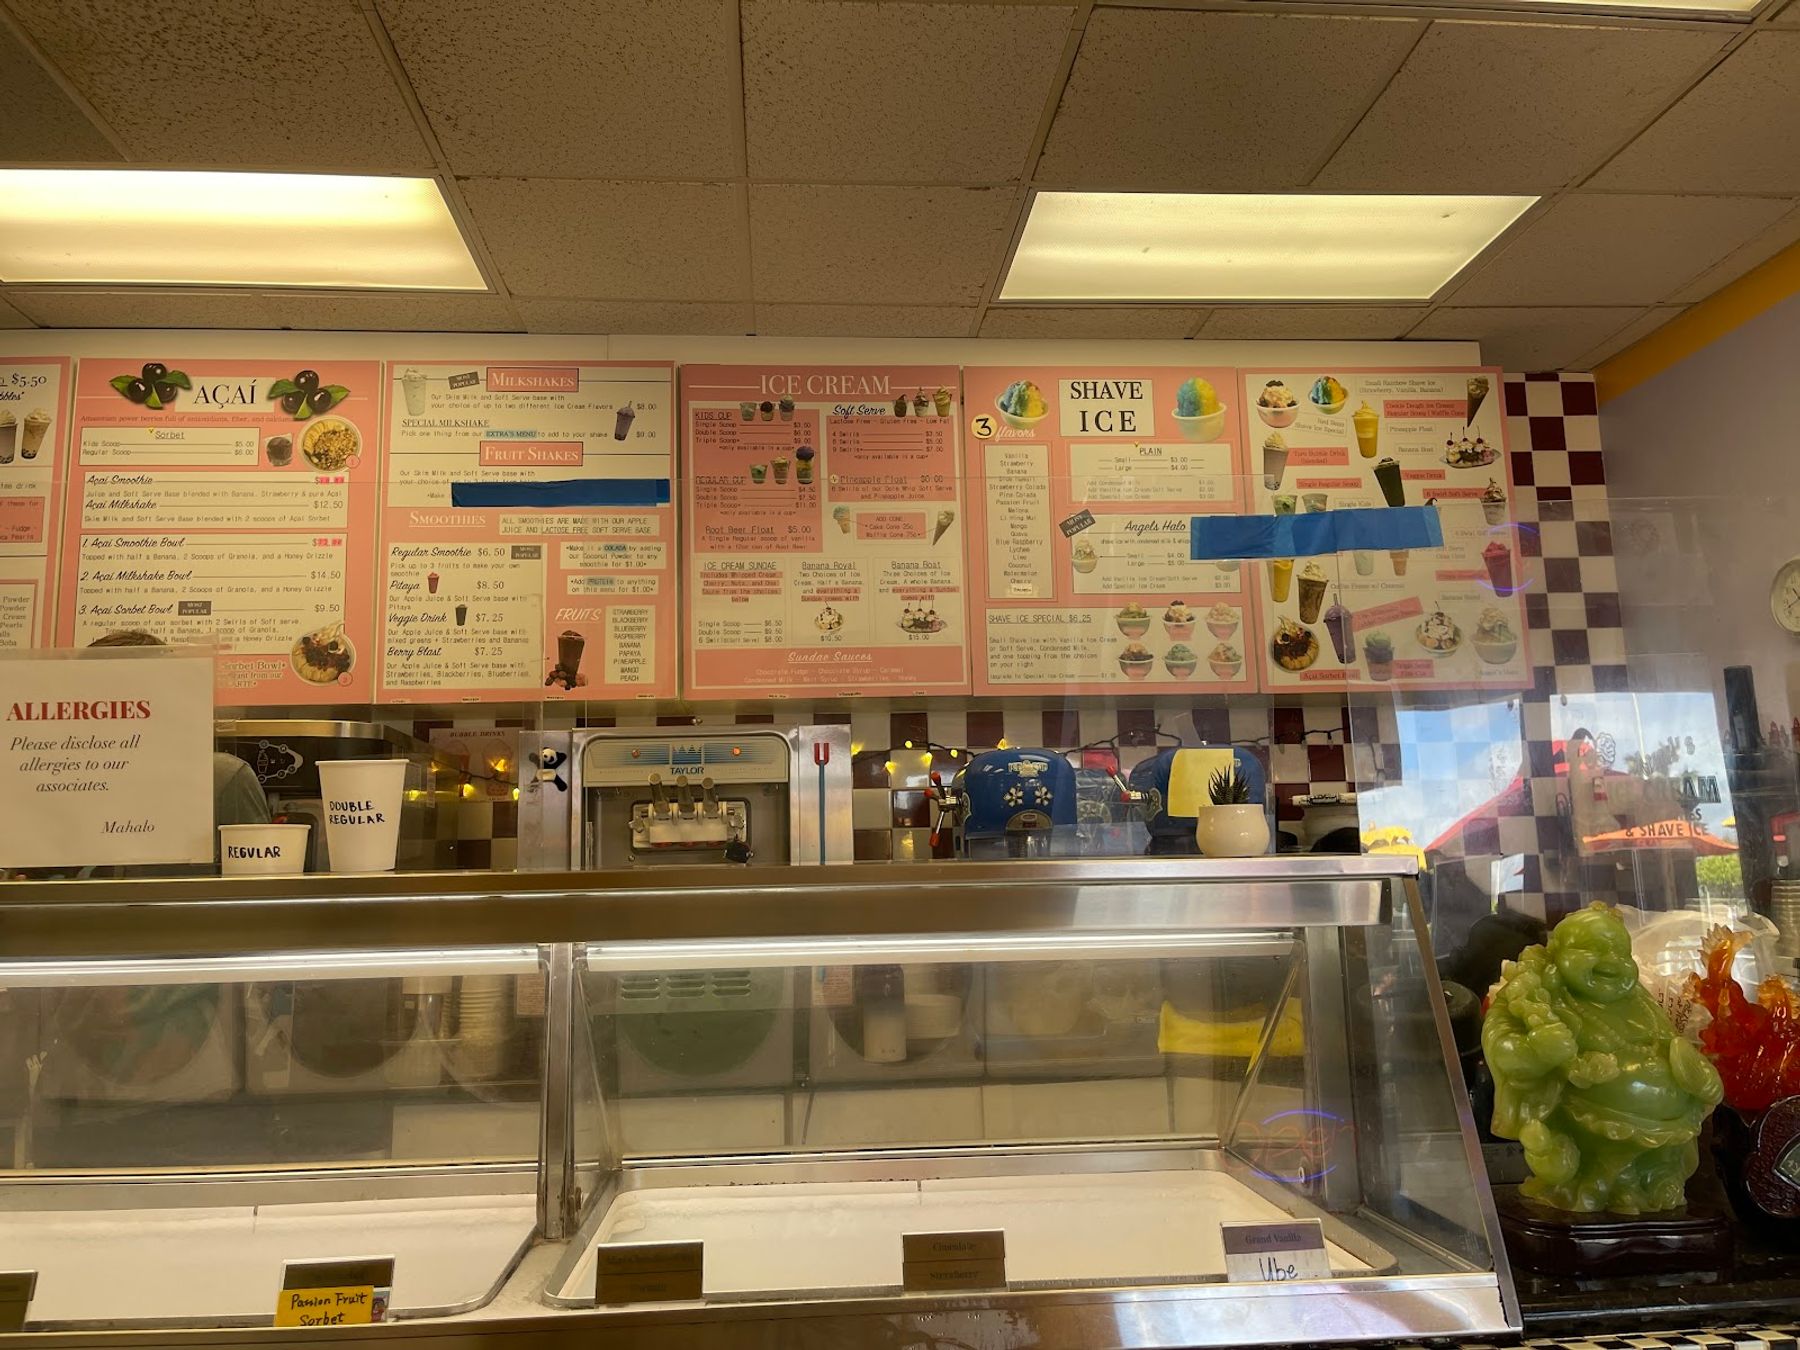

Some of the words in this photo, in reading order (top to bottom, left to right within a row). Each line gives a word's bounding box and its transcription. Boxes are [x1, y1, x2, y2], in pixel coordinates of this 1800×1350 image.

[11, 373, 48, 387] $5.50
[491, 372, 575, 387] MILKSHAKES
[760, 374, 802, 395] ICE
[806, 374, 890, 395] CREAM
[193, 379, 257, 409] AÇAÍ
[1070, 381, 1143, 400] SHAVE
[695, 412, 714, 420] KIDS
[717, 411, 732, 420] CUP
[832, 404, 855, 419] Soft
[856, 404, 886, 415] Serve
[402, 419, 437, 428] SPECIAL
[439, 419, 490, 428] MILKSHAKE
[975, 417, 992, 436] 3
[1079, 410, 1137, 432] ICE
[155, 430, 185, 440] Sorbet
[995, 426, 1036, 442] flavors
[101, 440, 121, 448] Scoop
[82, 448, 108, 457] Regular
[112, 448, 132, 456] Scoop
[485, 446, 525, 461] FRUIT
[528, 446, 580, 461] SHAKES
[1139, 448, 1163, 456] PLAIN
[110, 474, 153, 485] Smoothie
[108, 499, 156, 509] Milkshake
[314, 500, 344, 509] $12.50
[409, 510, 487, 527] SMOOTHIES
[705, 525, 724, 534] Root
[727, 525, 746, 534] Beer
[751, 525, 774, 534] Float
[787, 526, 811, 534] $5.00
[1124, 520, 1160, 536] Angels
[1161, 520, 1187, 531] Halo
[114, 538, 157, 548] Smoothie
[160, 537, 186, 548] Bowl
[391, 547, 429, 561] Regular
[430, 547, 472, 557] Smoothie
[703, 562, 717, 570] ICE
[720, 562, 746, 570] CREAM
[748, 561, 777, 570] SUNDAE
[802, 562, 830, 570] Banana
[833, 561, 857, 571] Royal
[891, 561, 919, 570] Banana
[922, 561, 941, 570] Boat
[116, 571, 165, 581] Milkshake
[167, 570, 192, 580] Bowl
[311, 571, 341, 580] $14.50
[389, 580, 420, 594] Pitaya
[114, 604, 147, 615] Sorbet
[148, 604, 174, 615] Bowl
[314, 604, 340, 613] $9.50
[555, 608, 602, 621] FRUITS
[388, 613, 418, 627] Veggie
[420, 612, 448, 623] Drink
[988, 615, 1011, 623] SHAVE
[1015, 615, 1029, 623] ICE
[1032, 615, 1063, 623] SPECIAL
[1068, 615, 1092, 623] $6.25
[387, 647, 415, 661] Berry
[416, 646, 443, 656] Blast
[787, 651, 829, 662] Sundae
[833, 651, 873, 662] Sauces
[6, 700, 151, 721] ALLERGIES
[10, 737, 57, 751] Please
[60, 735, 117, 751] disclose
[119, 734, 141, 749] all
[19, 757, 82, 775] allergies
[85, 760, 99, 770] to
[103, 761, 130, 770] our
[670, 767, 705, 775] TAYLOR
[36, 779, 109, 792] associates.
[329, 801, 374, 812] DOUBLE
[329, 813, 385, 825] REGULAR
[100, 820, 155, 833] Mahalo
[1640, 823, 1684, 836] SHAVE
[228, 846, 281, 858] REGULAR
[1246, 1234, 1272, 1245] Grand
[1273, 1232, 1302, 1242] Vanilla
[1259, 1256, 1298, 1282] Ube
[291, 1293, 331, 1310] Passion
[335, 1292, 368, 1306] Fruit
[299, 1311, 345, 1326] Sorbet
